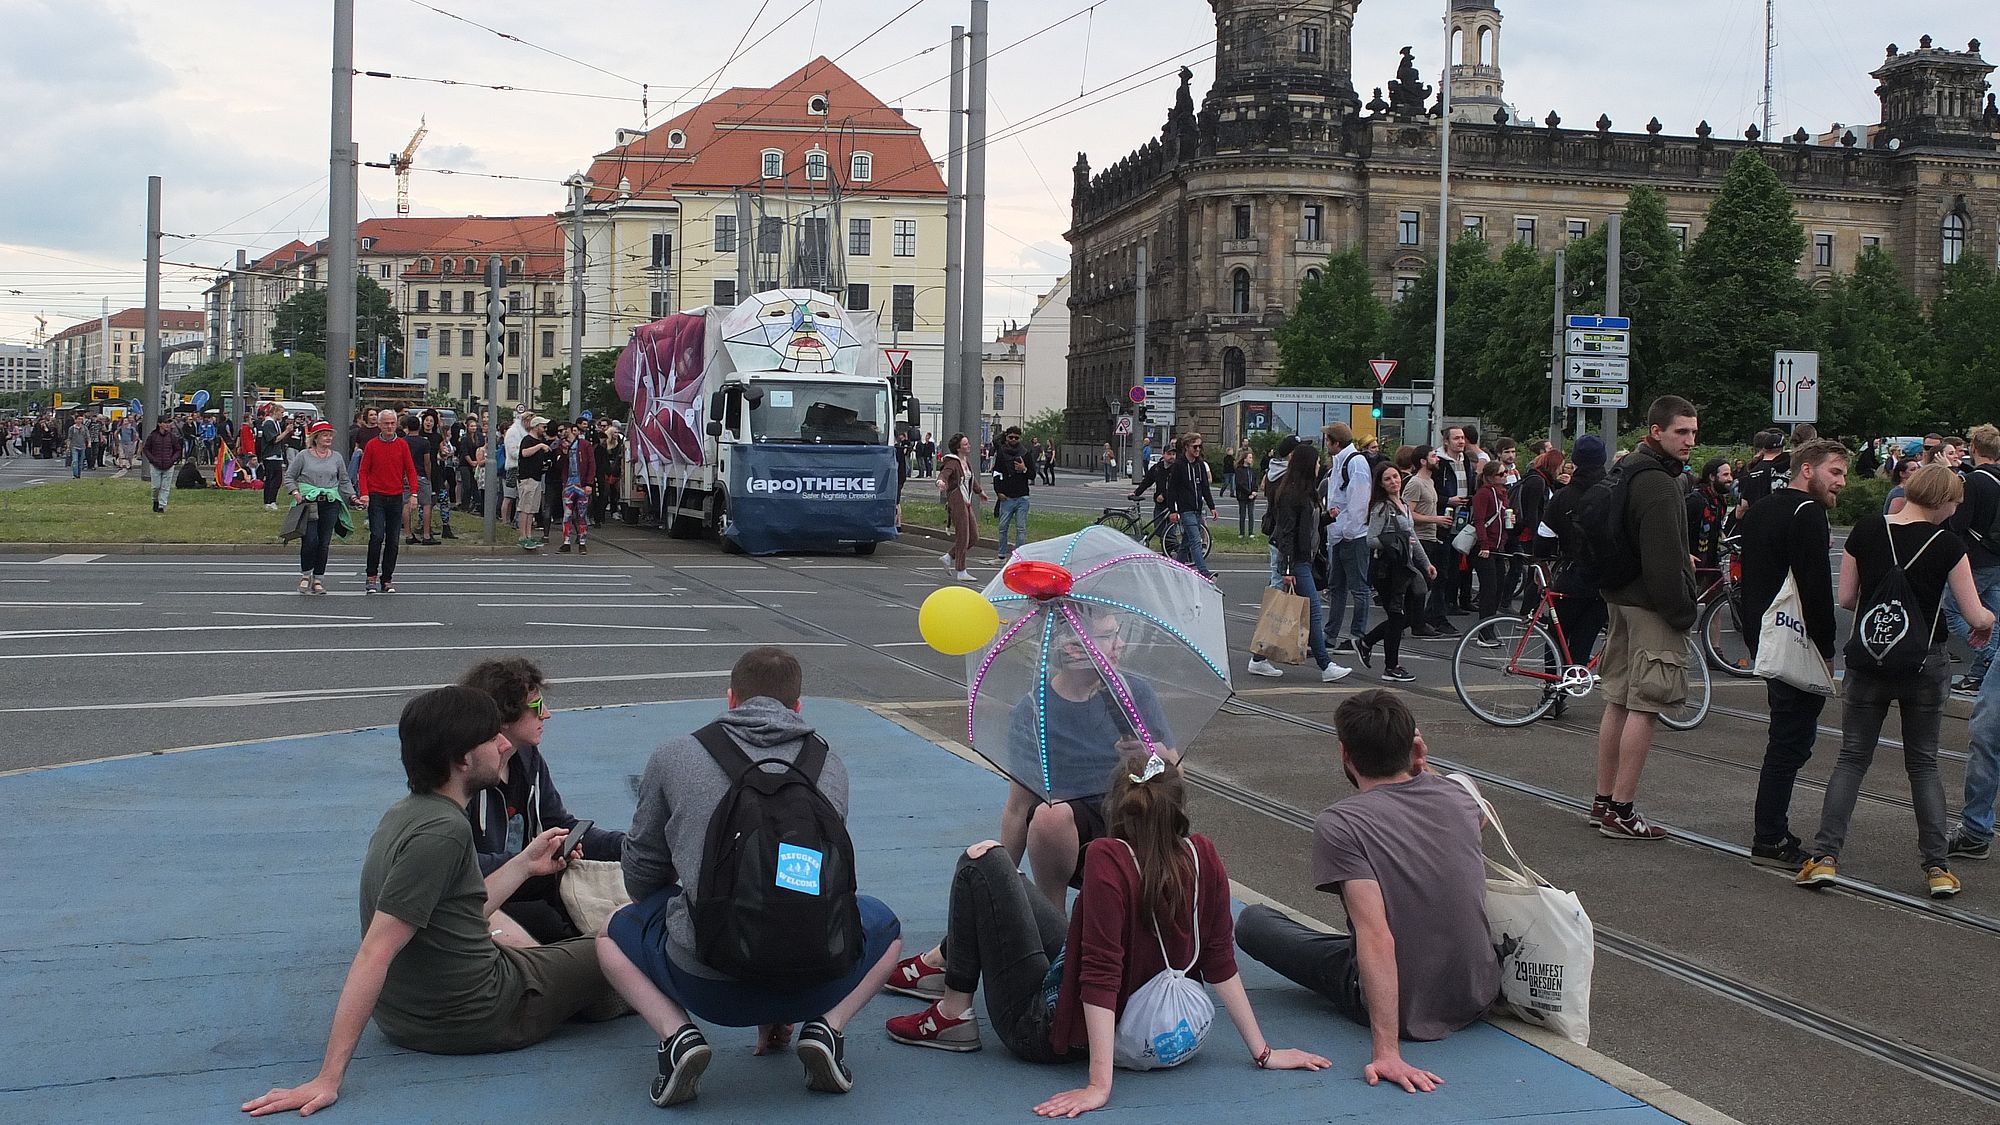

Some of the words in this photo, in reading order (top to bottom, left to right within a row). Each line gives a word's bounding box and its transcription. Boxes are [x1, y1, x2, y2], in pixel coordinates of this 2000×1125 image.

[1597, 318, 1602, 327] P
[1595, 343, 1600, 351] 5
[1256, 415, 1265, 428] P
[746, 476, 876, 494] (apo)THEKE
[779, 871, 818, 888] WELCOME
[1514, 960, 1529, 982] 29
[1528, 962, 1564, 978] FILMFEST
[1528, 975, 1563, 991] DRESDEN
